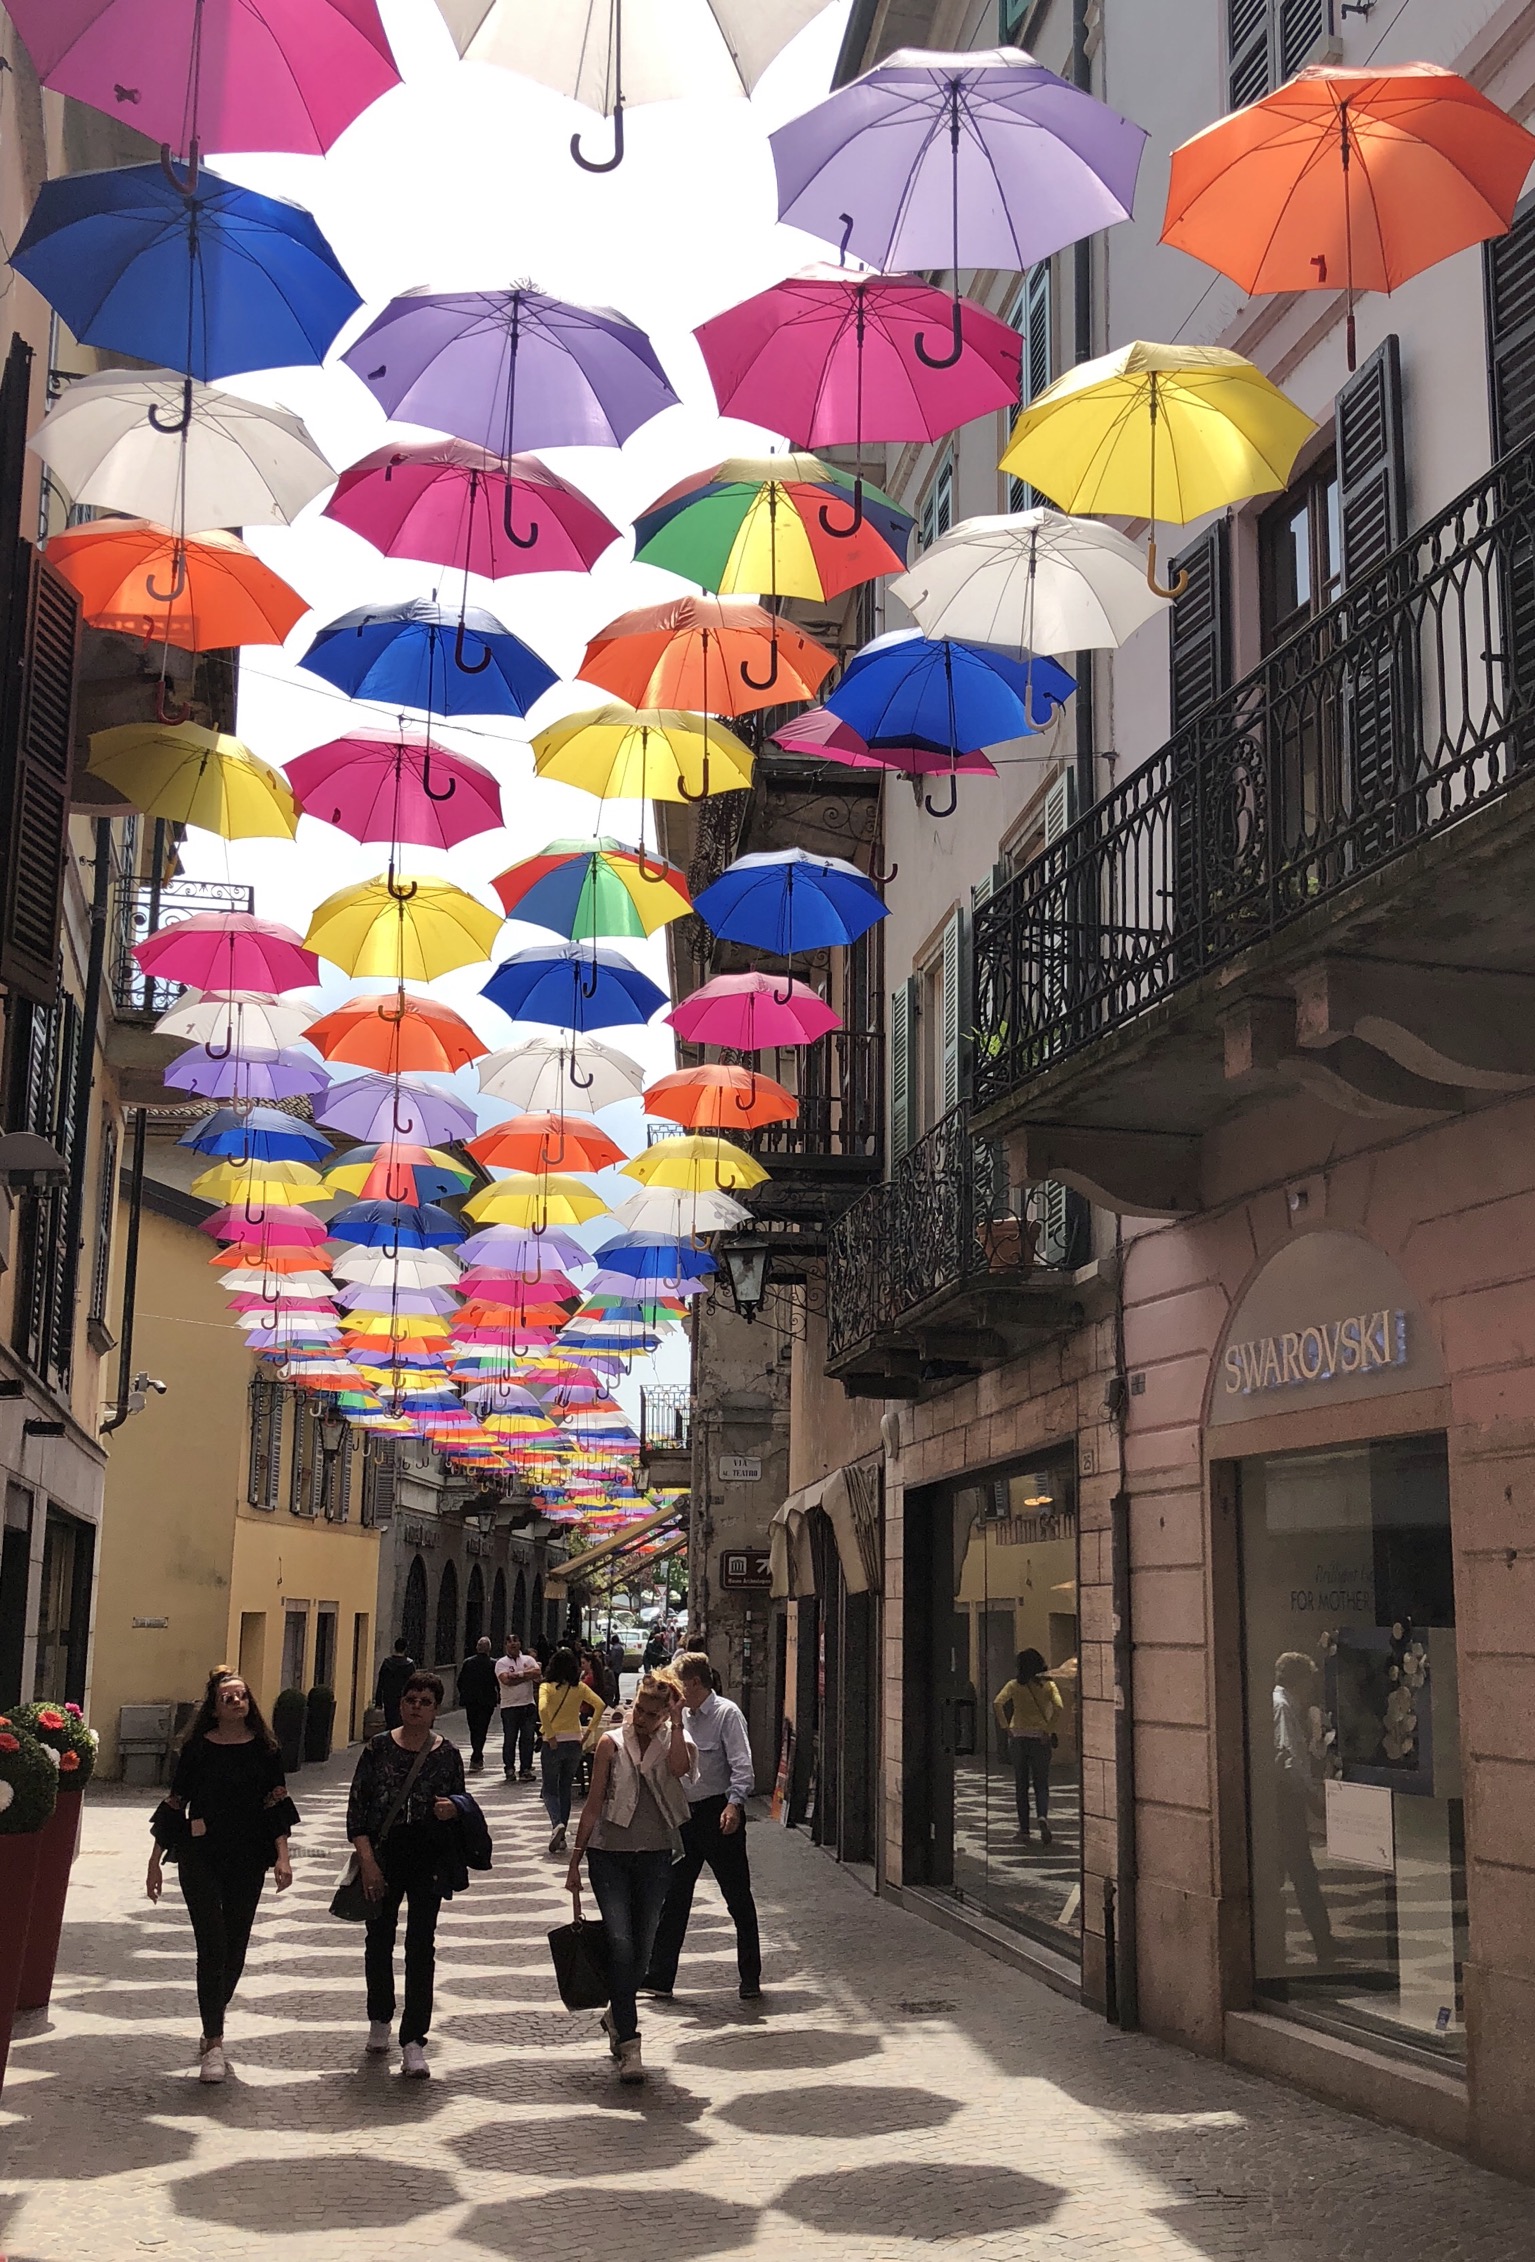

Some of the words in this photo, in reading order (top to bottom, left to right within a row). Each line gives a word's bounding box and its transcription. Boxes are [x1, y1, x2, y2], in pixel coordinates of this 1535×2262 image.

[1225, 1310, 1392, 1394] SWAROVSKI
[733, 1459, 747, 1467] VIA
[733, 1469, 758, 1477] TEATRO
[1290, 1590, 1314, 1611] FOR
[508, 1665, 516, 1673] 3
